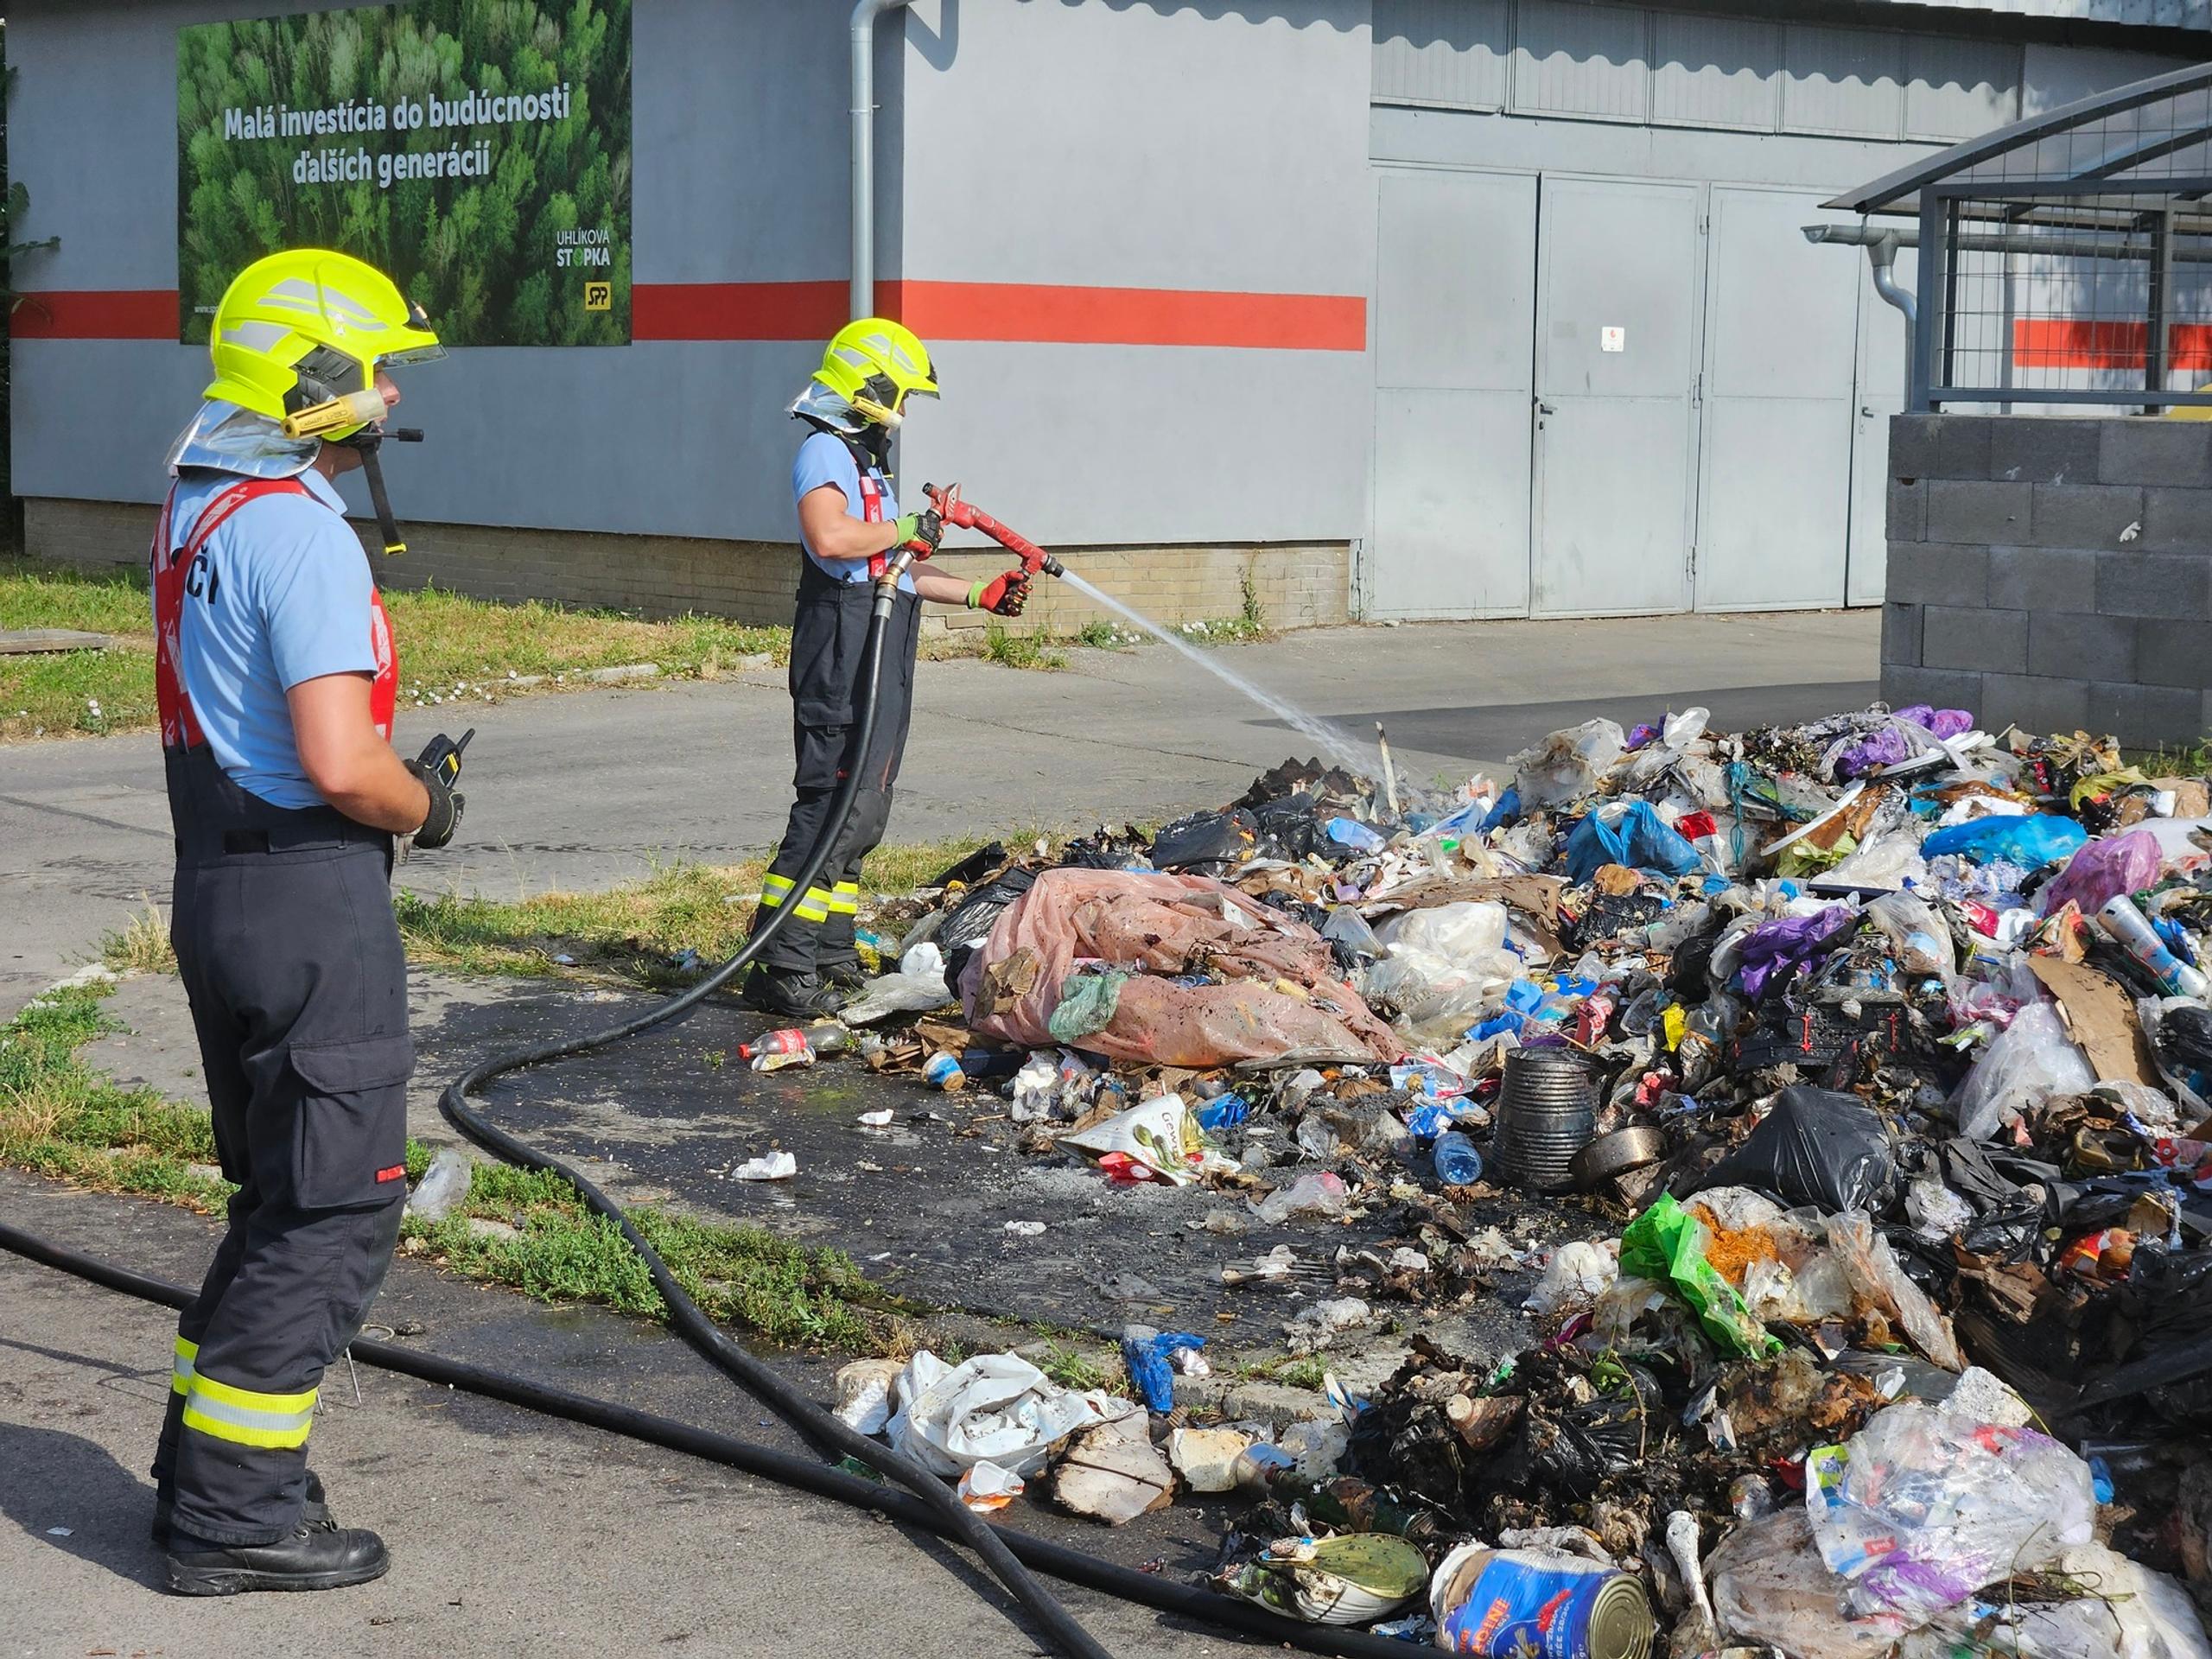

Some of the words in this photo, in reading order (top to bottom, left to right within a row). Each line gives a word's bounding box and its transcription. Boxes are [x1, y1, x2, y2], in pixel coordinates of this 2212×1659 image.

[225, 105, 276, 141] Malá
[281, 97, 386, 137] investícia
[393, 95, 423, 130] do
[429, 82, 569, 127] budúcnosti
[293, 147, 372, 184] ďalších
[378, 139, 491, 189] generácií
[556, 226, 610, 245] UHLÍKOVÁ
[588, 286, 608, 305] SPP
[1459, 1629, 1471, 1655] UIGI
[1471, 1598, 1510, 1656] ADINI
